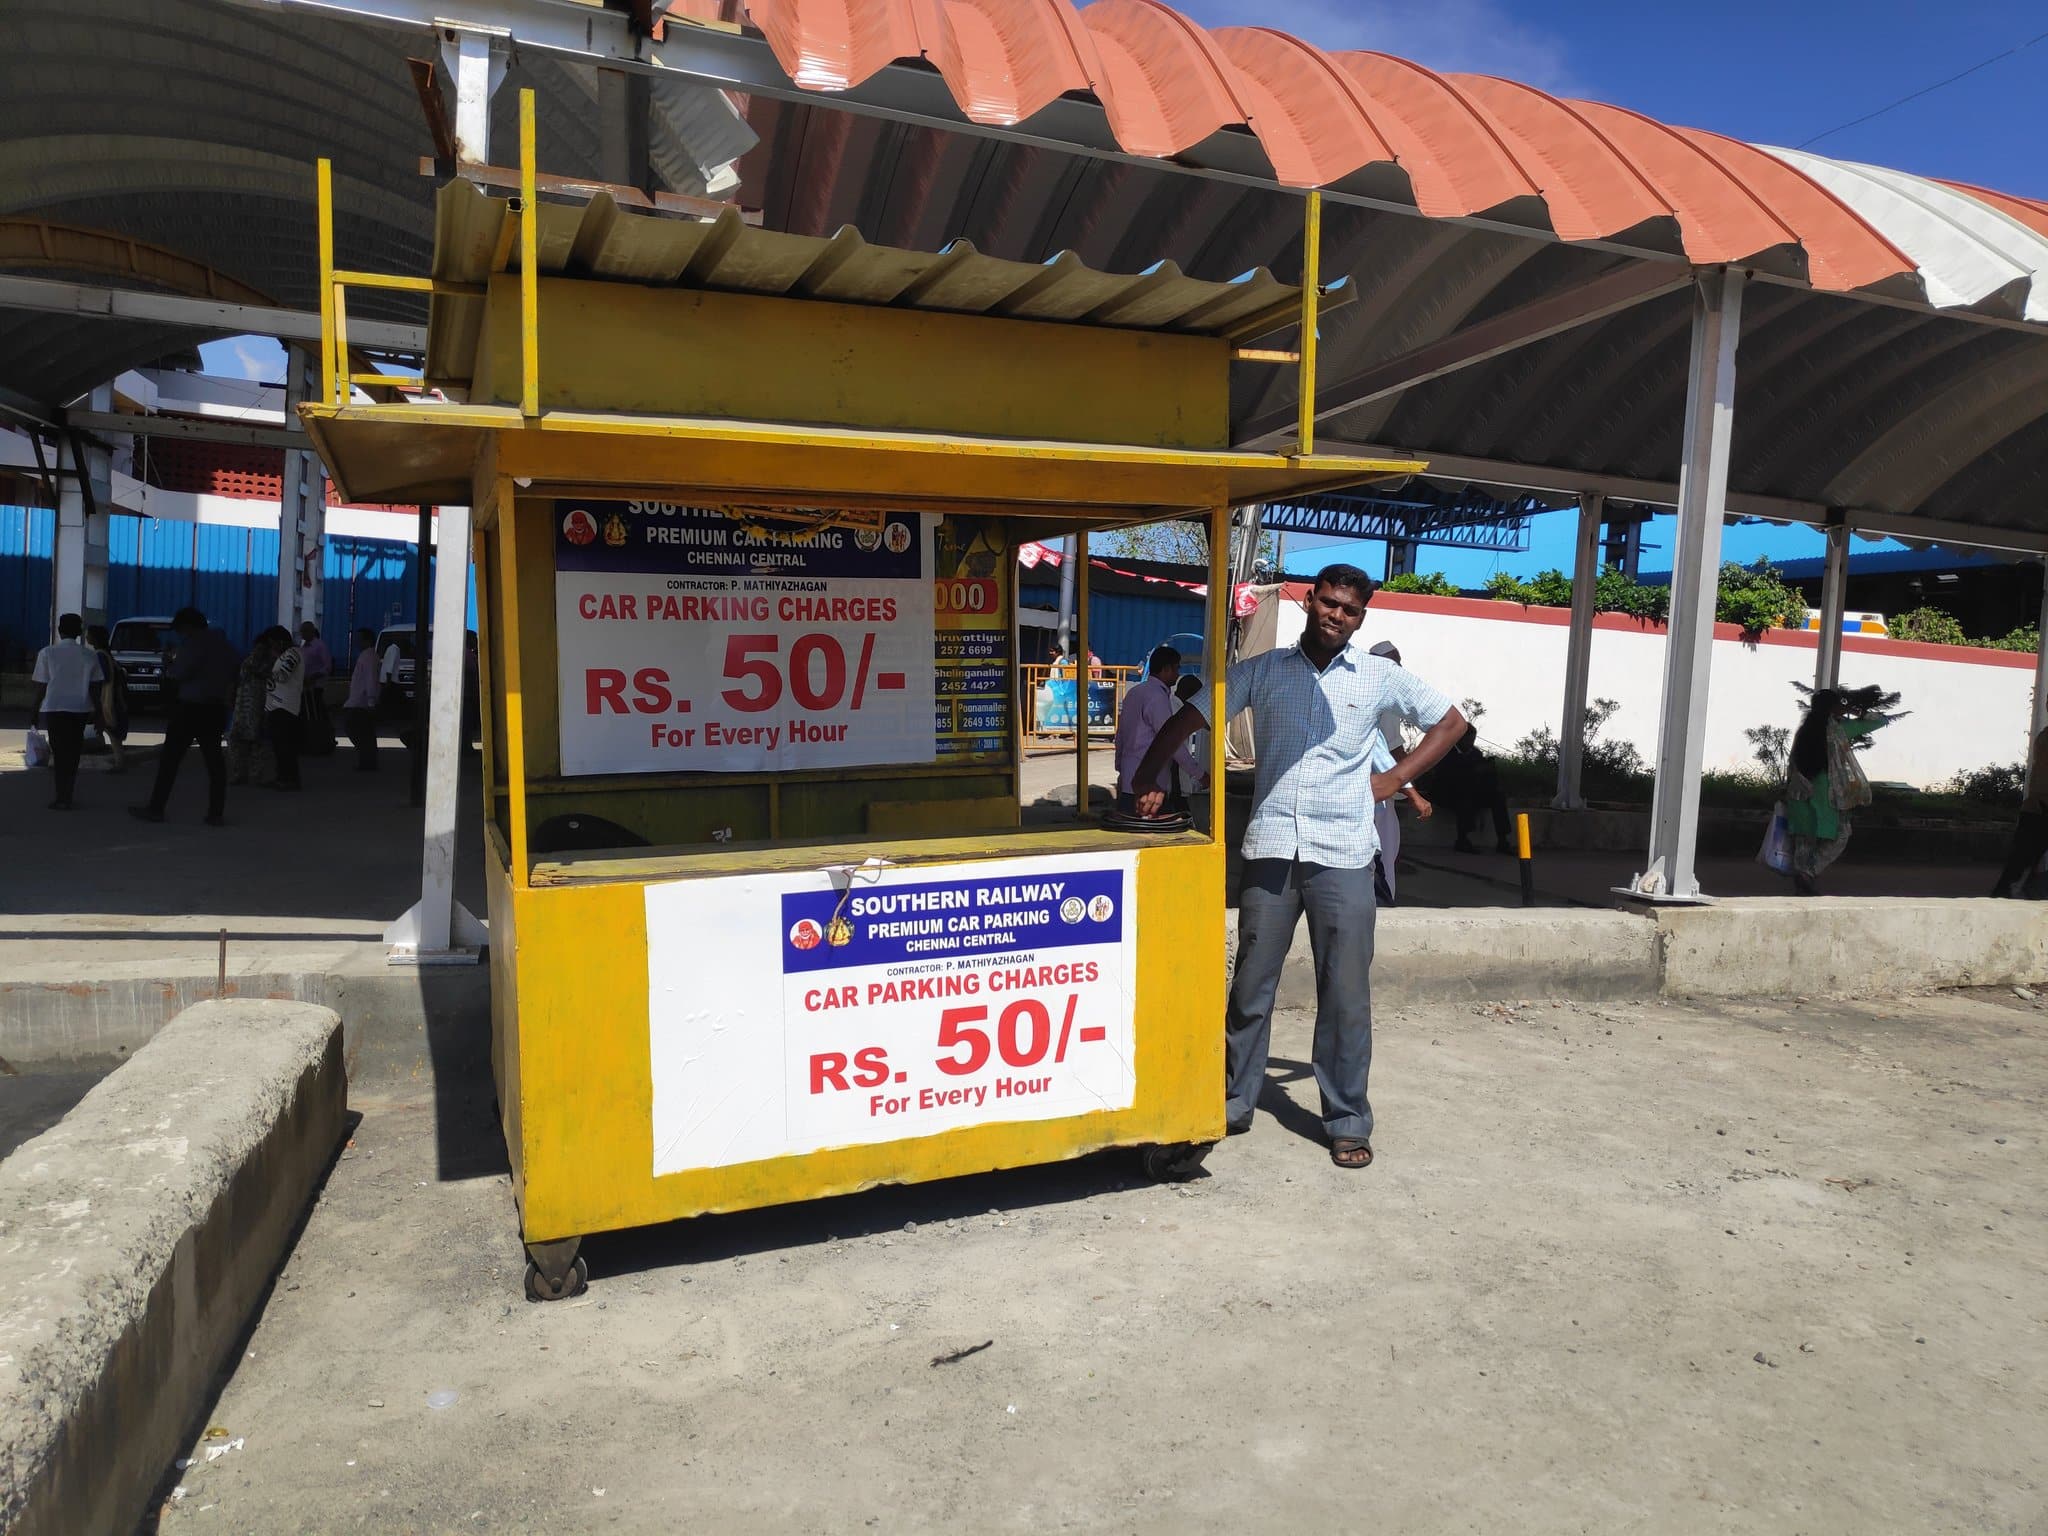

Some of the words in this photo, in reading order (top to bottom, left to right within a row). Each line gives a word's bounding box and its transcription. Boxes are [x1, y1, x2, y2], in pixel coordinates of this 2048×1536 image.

[646, 526, 727, 546] PREMIUM
[687, 551, 745, 565] CHENNAI
[750, 553, 806, 567] CENTRAL
[667, 580, 728, 591] CONTRACTOR:
[731, 581, 741, 591] P.
[743, 581, 827, 592] MATHIYAZHAGAN
[579, 594, 638, 620] CAR
[646, 595, 770, 621] PARKING
[777, 597, 897, 622] CHARGES
[941, 645, 966, 656] 2572
[968, 645, 993, 655] 6699
[586, 668, 691, 714] RS.
[721, 633, 905, 713] 50/-
[941, 681, 967, 692] 2452
[651, 723, 696, 748] For
[704, 722, 780, 751] Every
[789, 720, 848, 743] Hour
[962, 717, 983, 728] 2649
[851, 889, 970, 917] SOUTHERN
[976, 882, 1066, 907] RAILWAY
[868, 918, 943, 940] PREMIUM
[947, 915, 980, 933] CAR
[984, 909, 1050, 930] PARKING
[906, 936, 960, 953] CHENNAI
[963, 931, 1017, 947] CENTRAL
[886, 963, 944, 977] CONTRACTOR:
[946, 961, 956, 971] P.
[957, 953, 1035, 970] MATHIYAZHAGAN
[804, 986, 859, 1012] CAR
[867, 973, 980, 1005] PARKING
[988, 961, 1099, 993] CHARGES
[809, 1047, 907, 1095] RS.
[935, 993, 1106, 1076] 50/-
[870, 1095, 911, 1117] For
[919, 1085, 987, 1109] Every
[996, 1077, 1052, 1099] Hour
